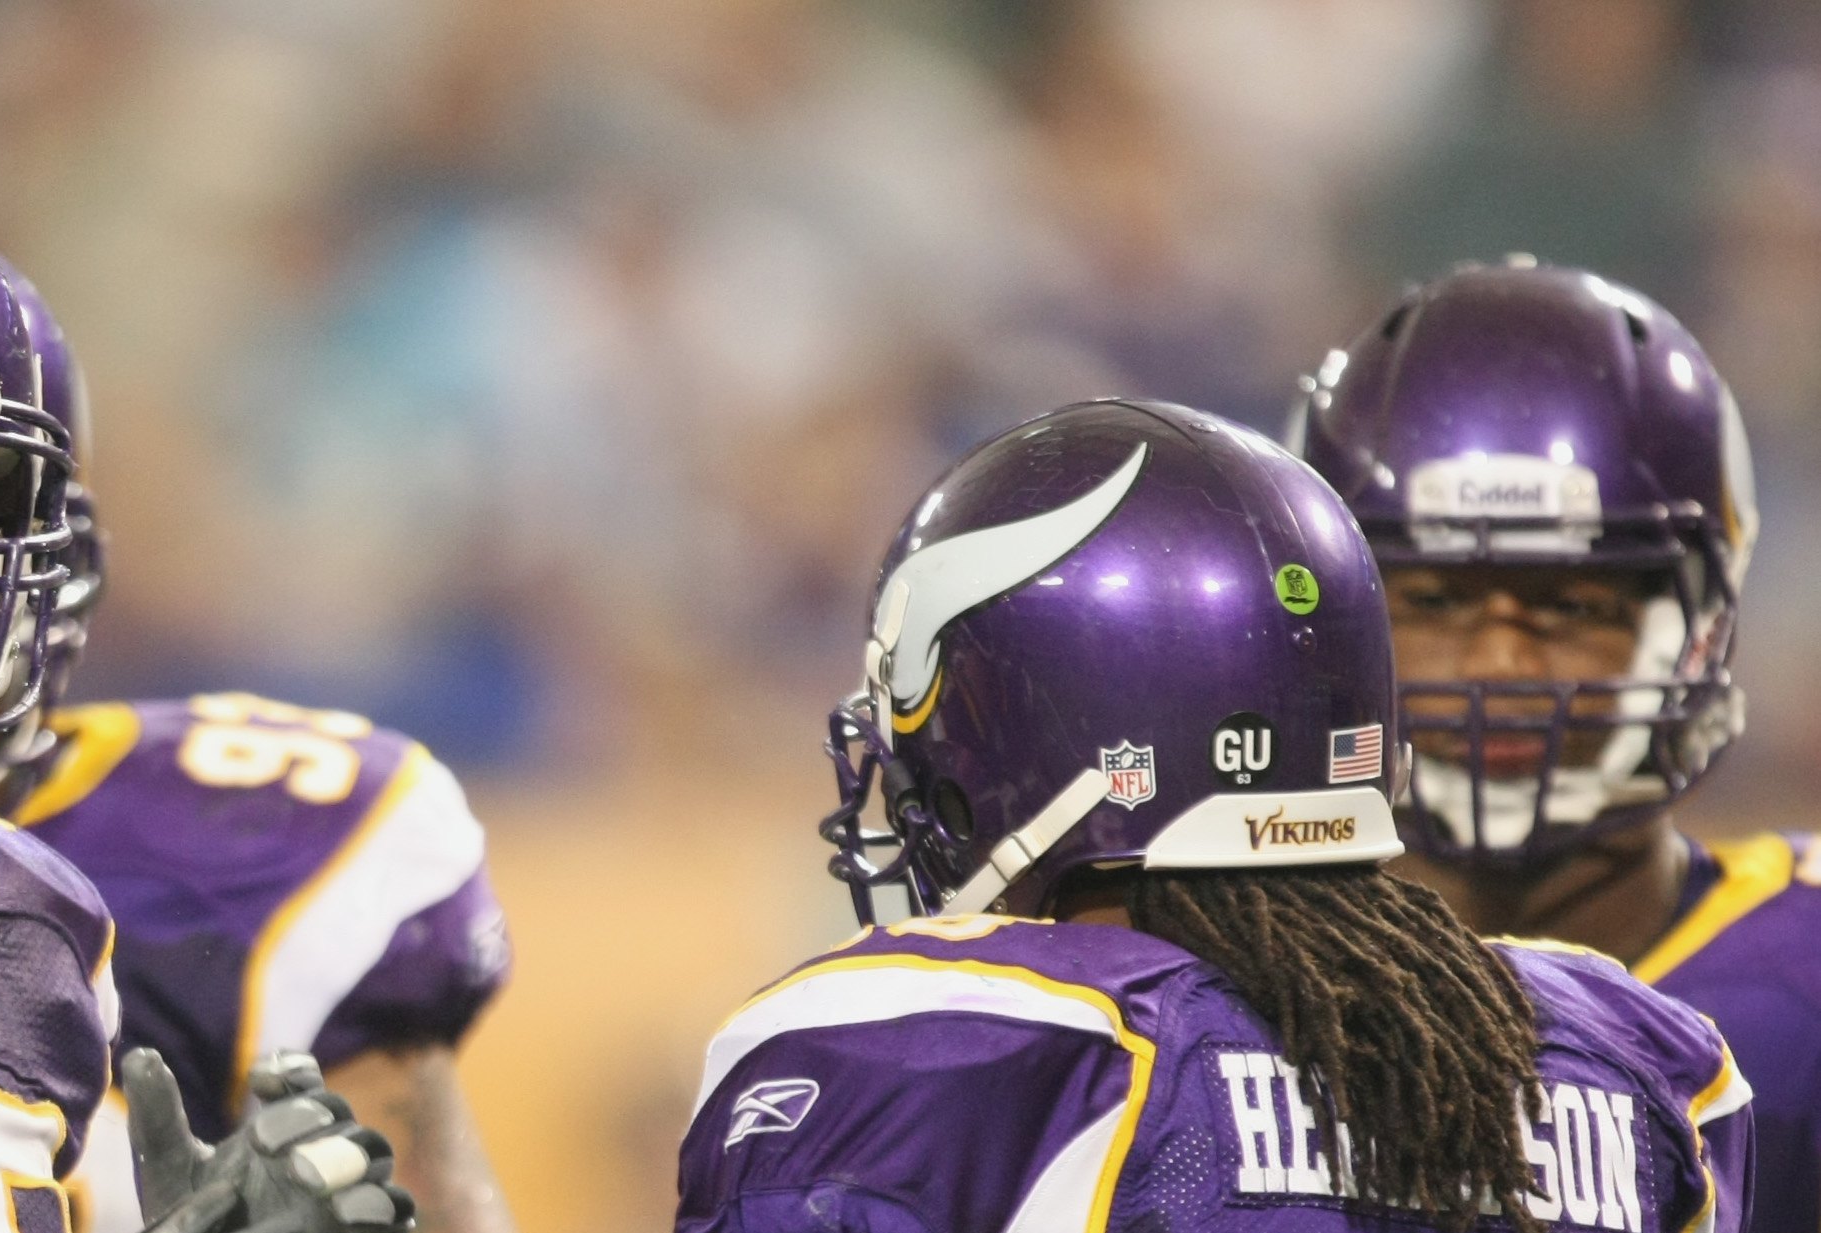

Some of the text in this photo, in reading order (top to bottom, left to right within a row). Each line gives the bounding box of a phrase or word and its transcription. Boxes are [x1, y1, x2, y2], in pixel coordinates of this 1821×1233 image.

[1215, 728, 1271, 772] GU
[1110, 769, 1149, 797] NFL
[1236, 773, 1252, 784] 63
